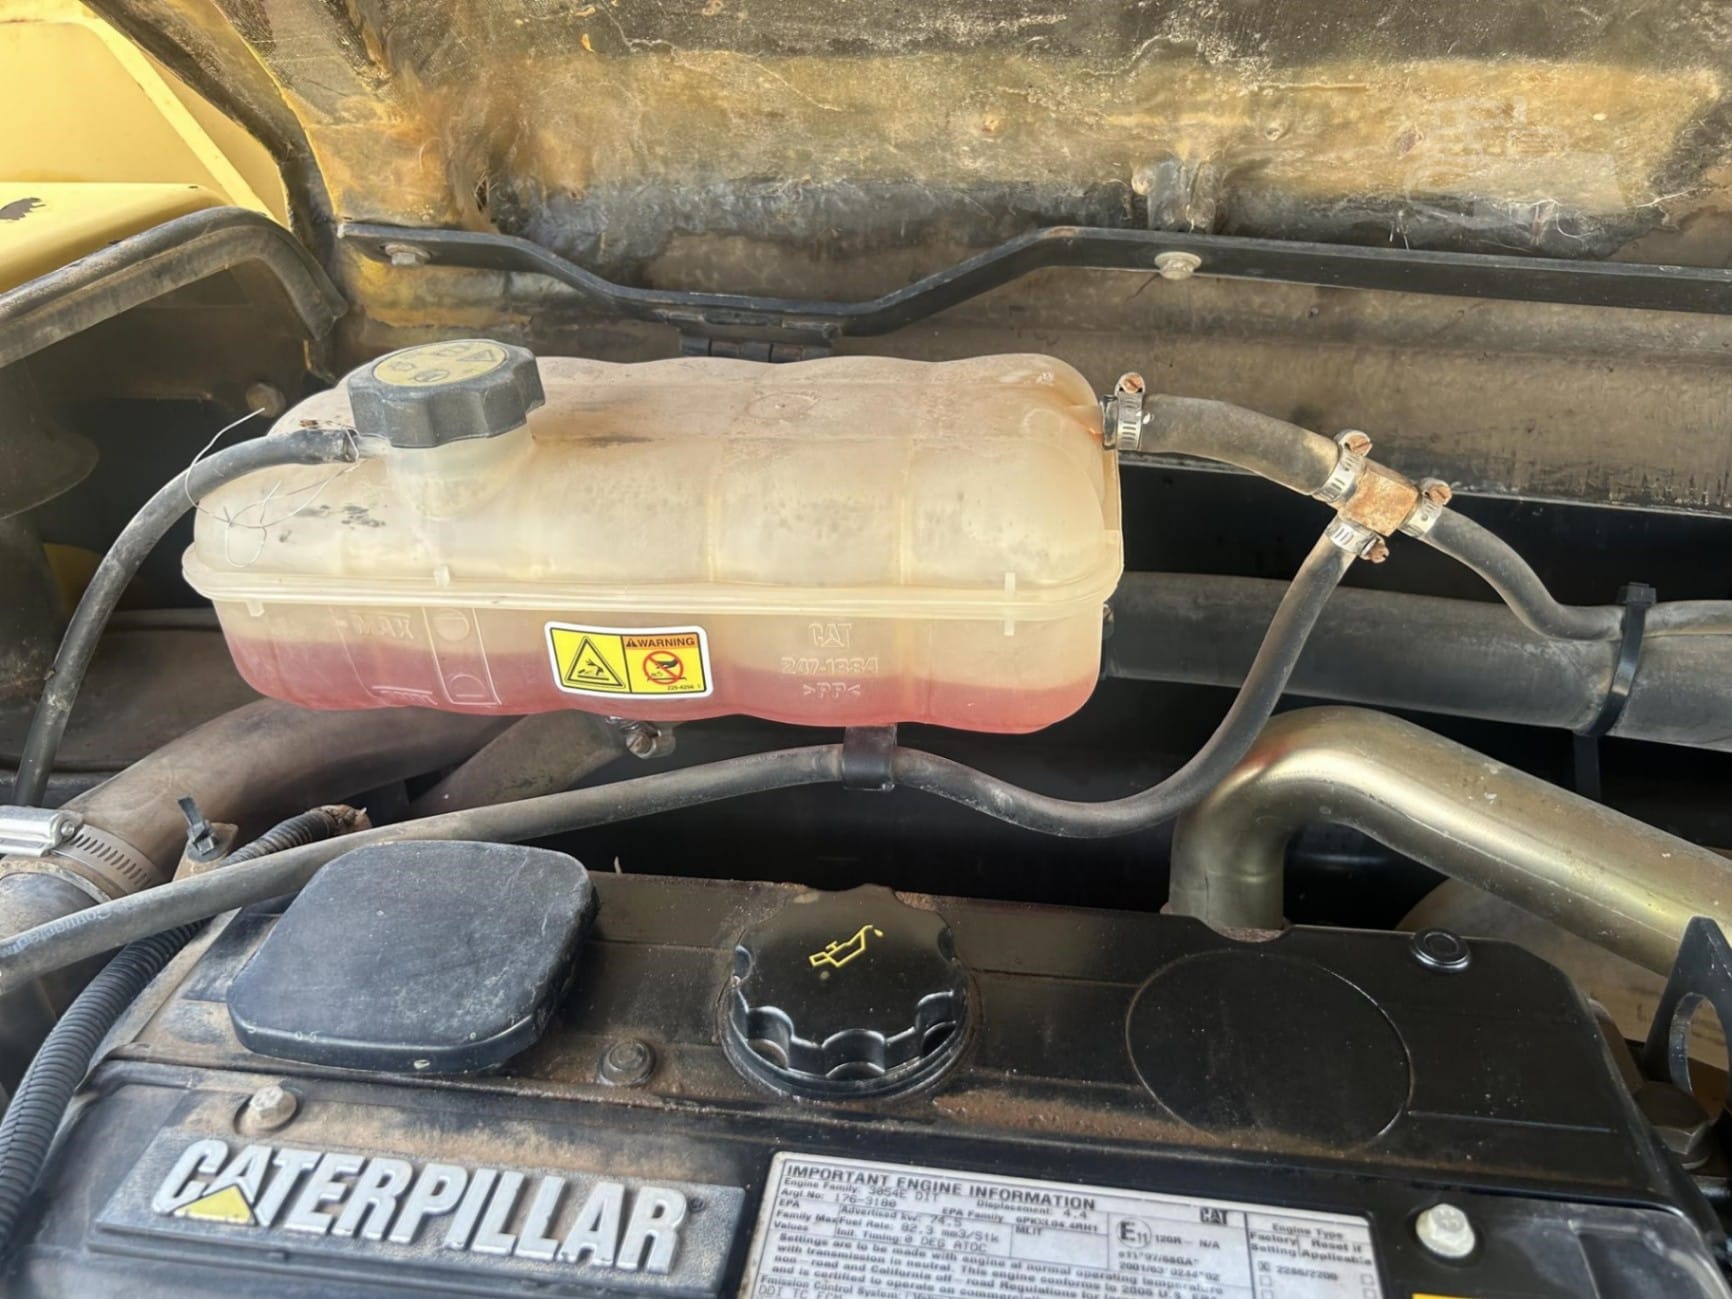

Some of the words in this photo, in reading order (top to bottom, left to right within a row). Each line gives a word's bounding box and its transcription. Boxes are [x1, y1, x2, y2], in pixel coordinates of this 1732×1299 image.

[637, 637, 695, 648] WARNING
[808, 622, 852, 649] CAT
[788, 1164, 888, 1187] IMPORTANT
[897, 1176, 960, 1195] ENGINE
[969, 1184, 1094, 1210] INFORMATION
[151, 1137, 690, 1275] CATERPILLAR
[778, 1198, 799, 1207] EPA
[1200, 1207, 1226, 1225] CAT
[1199, 1239, 1219, 1249] N/A
